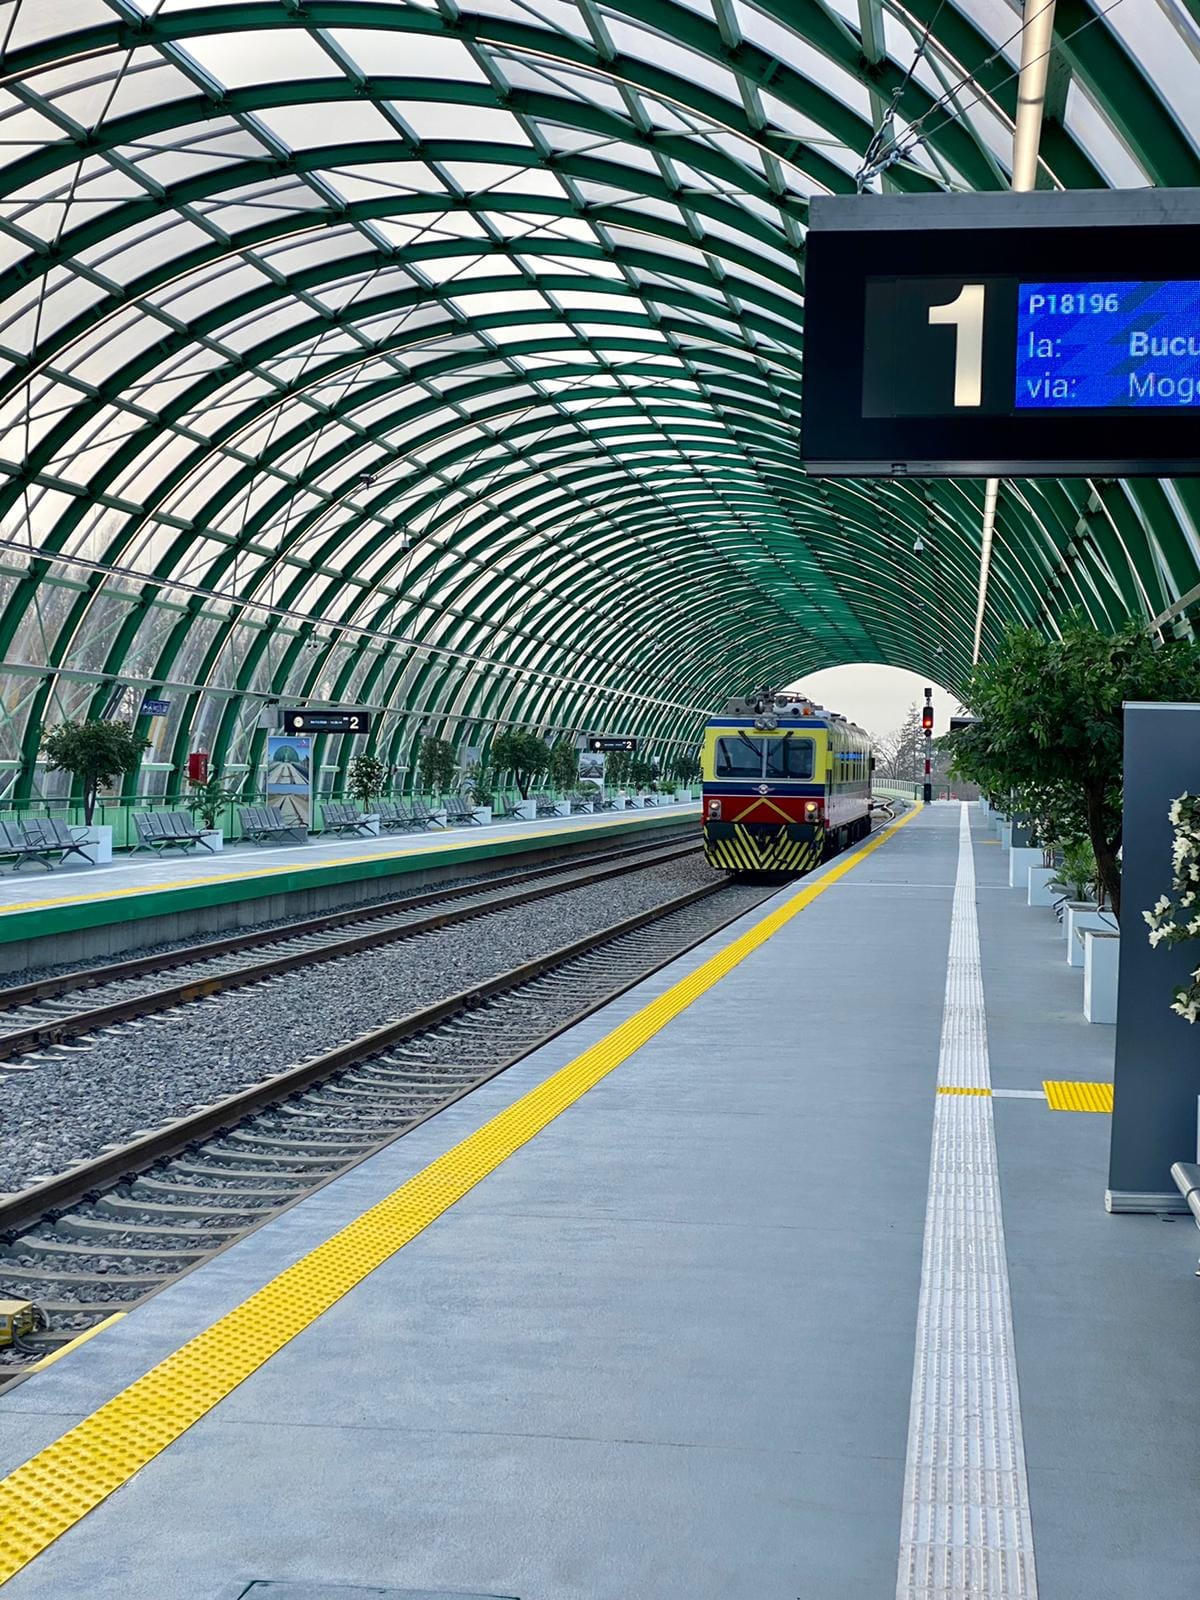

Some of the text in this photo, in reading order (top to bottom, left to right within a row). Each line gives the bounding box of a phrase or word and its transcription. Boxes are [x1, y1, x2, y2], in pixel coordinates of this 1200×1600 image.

[1028, 293, 1119, 315] P18196
[928, 283, 986, 407] 1
[1028, 330, 1200, 358] la: Bucu
[1026, 371, 1200, 404] via: Mog
[349, 716, 360, 730] 2
[626, 740, 632, 749] 2
